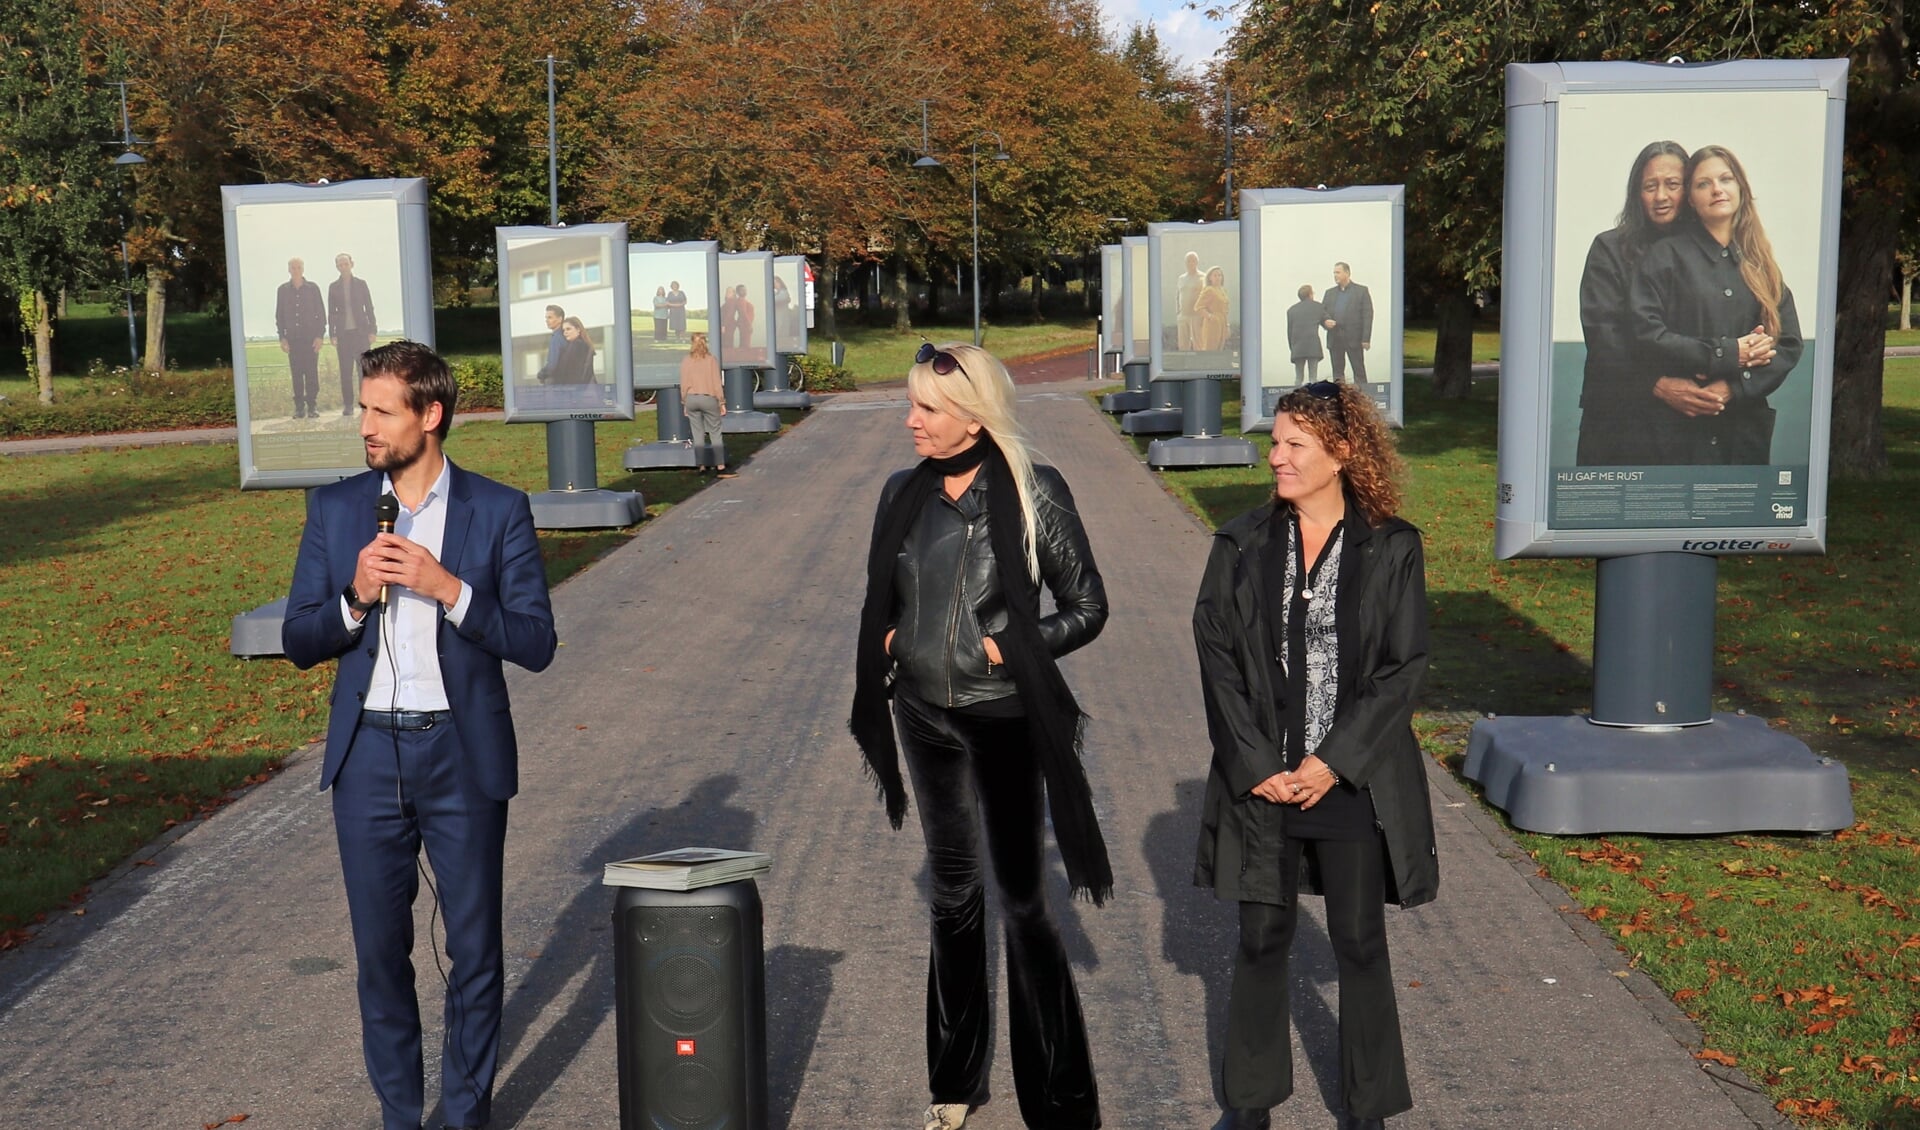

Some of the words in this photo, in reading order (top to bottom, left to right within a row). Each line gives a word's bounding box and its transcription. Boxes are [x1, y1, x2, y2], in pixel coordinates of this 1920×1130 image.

[1557, 472, 1573, 481] HIJ
[1575, 472, 1597, 481] GAF
[1599, 472, 1614, 481] ME
[1616, 471, 1644, 481] RUST
